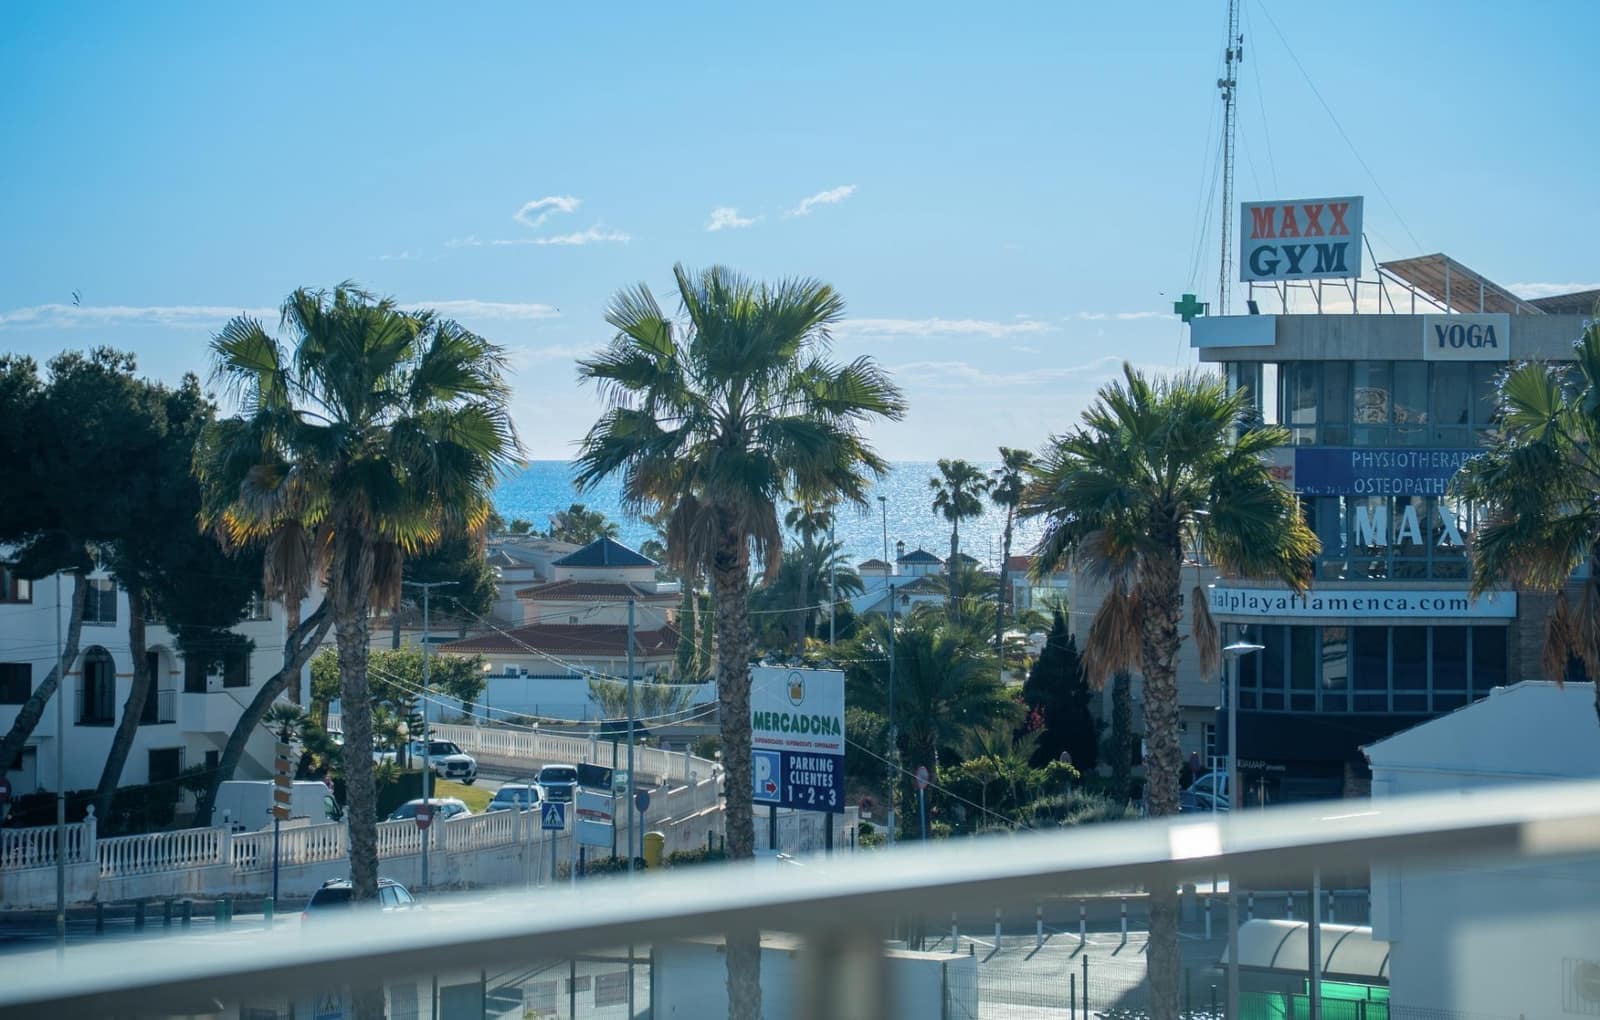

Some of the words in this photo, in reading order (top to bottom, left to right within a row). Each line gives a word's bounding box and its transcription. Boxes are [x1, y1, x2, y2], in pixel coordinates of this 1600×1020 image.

[1250, 202, 1350, 239] MAXX
[1249, 242, 1350, 276] GYM
[1434, 324, 1498, 348] YOGA
[1352, 451, 1473, 468] PHYSIOTHERAP
[753, 711, 841, 736] MERCADONA
[755, 756, 771, 793] P
[790, 756, 834, 772] PARKING
[790, 771, 834, 788] CLIENTES
